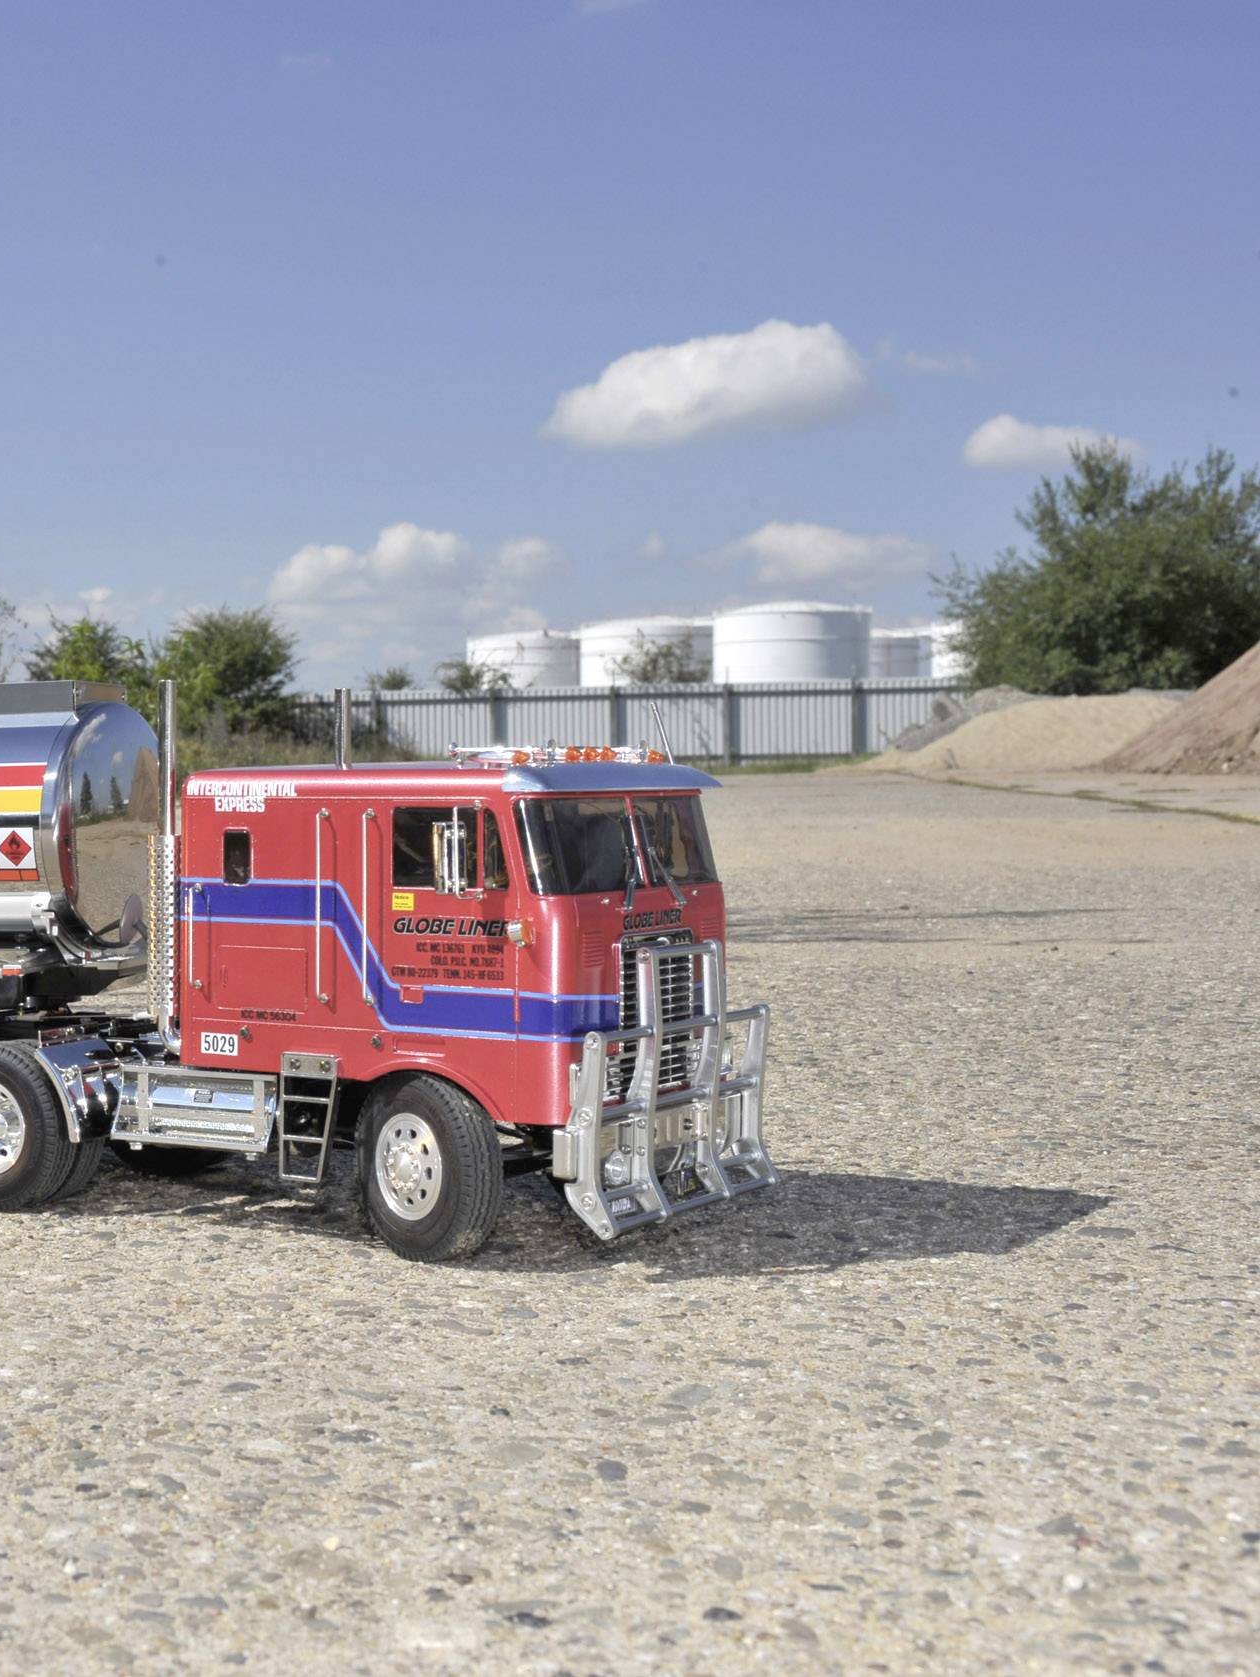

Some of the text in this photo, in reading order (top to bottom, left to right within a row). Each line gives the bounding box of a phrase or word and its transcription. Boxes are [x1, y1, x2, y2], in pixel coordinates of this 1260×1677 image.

[186, 780, 298, 797] INTERCONTINENTAL
[214, 796, 266, 812] EXPRESS
[393, 916, 456, 935] GLOBE
[623, 908, 682, 931] GLOBE LINER
[204, 1034, 235, 1054] 5029
